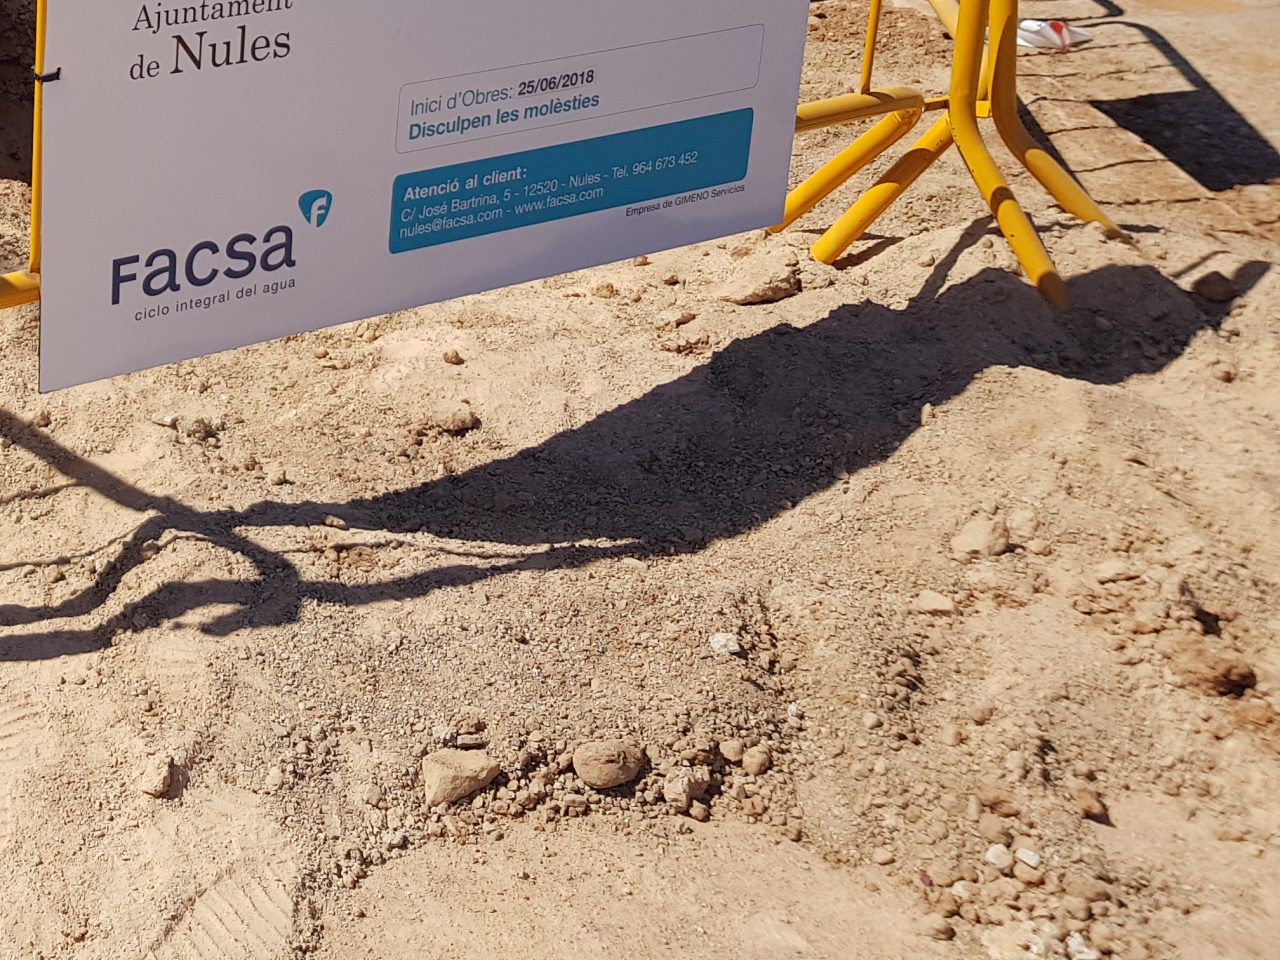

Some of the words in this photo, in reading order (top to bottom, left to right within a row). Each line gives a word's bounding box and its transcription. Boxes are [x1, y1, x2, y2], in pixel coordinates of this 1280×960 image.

[130, 54, 160, 80] de
[170, 25, 291, 74] Nules
[410, 95, 442, 116] Inici
[518, 69, 594, 96] 25/06/2018
[409, 113, 491, 140] Disculpen
[496, 108, 519, 125] les
[524, 93, 600, 119] molèsties
[400, 208, 415, 222] C/
[418, 202, 448, 219] José
[451, 194, 500, 213] Bartrina,
[503, 189, 511, 202] 5
[523, 179, 558, 198] 12520
[569, 172, 601, 188] Nules
[612, 166, 629, 180] Tel.
[632, 159, 652, 176] 964
[655, 155, 676, 171] 673
[677, 150, 699, 167] 452
[403, 178, 459, 202] Atenció
[465, 174, 478, 189] al
[483, 167, 528, 186] client:
[625, 203, 660, 218] Empresa
[662, 199, 673, 209] de
[674, 192, 709, 206] GIMENO
[710, 184, 746, 199] Servicios
[399, 208, 503, 239] nules@facsa.com
[514, 186, 604, 215] www.facsa.com
[111, 225, 296, 305] Facsa
[135, 305, 170, 321] ciclo
[176, 290, 230, 312] integral
[236, 285, 257, 299] del
[263, 279, 296, 295] agua
